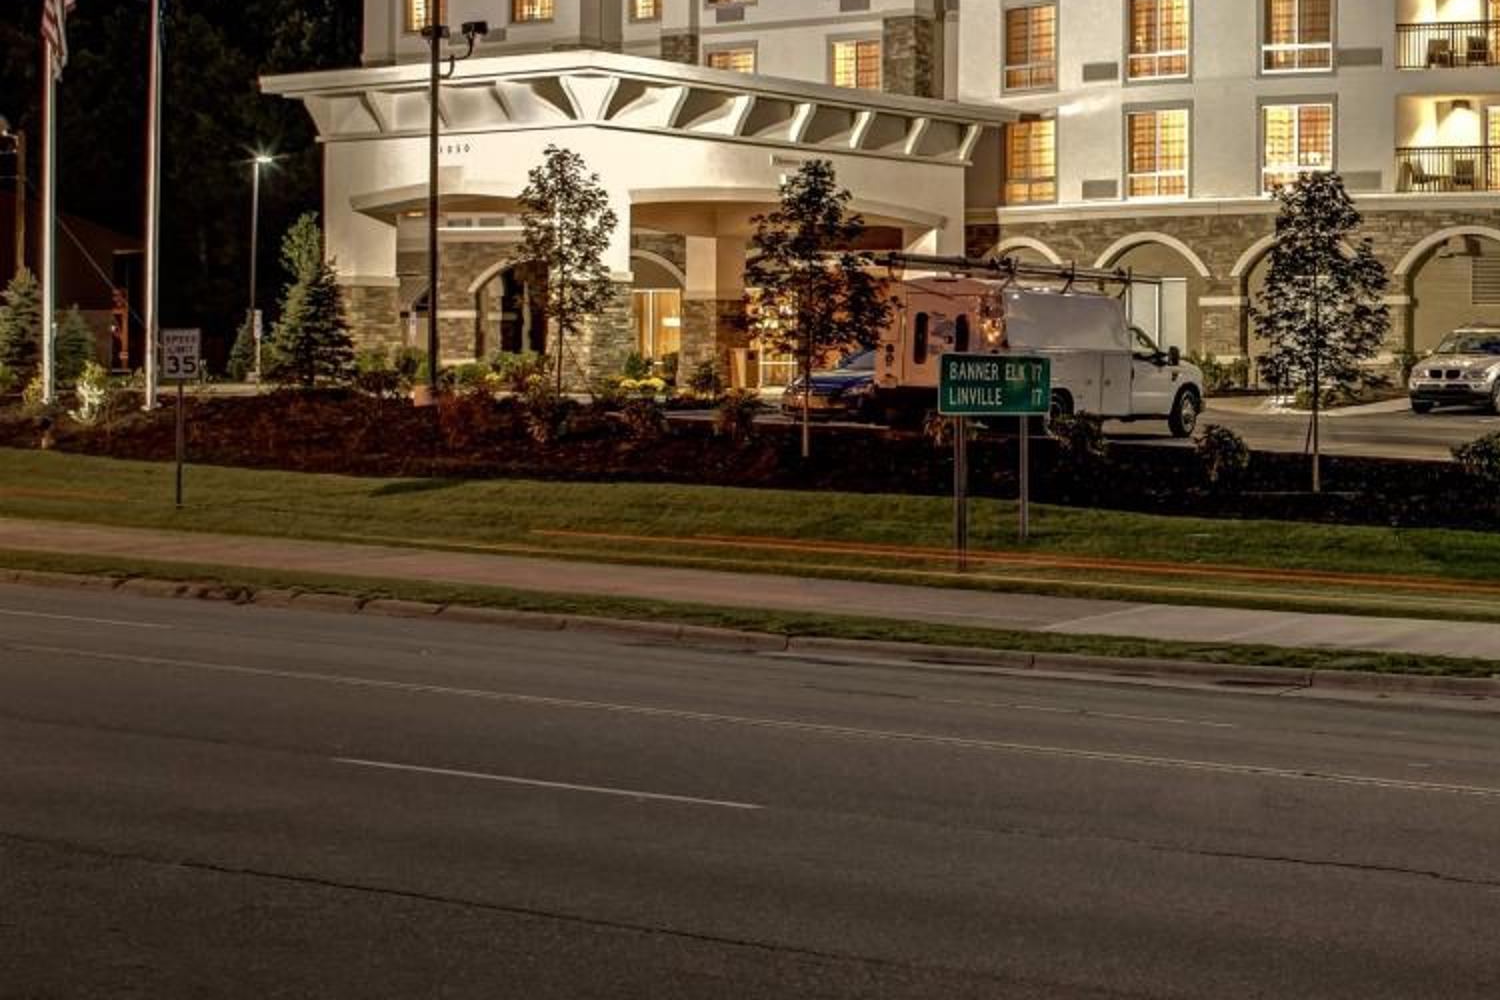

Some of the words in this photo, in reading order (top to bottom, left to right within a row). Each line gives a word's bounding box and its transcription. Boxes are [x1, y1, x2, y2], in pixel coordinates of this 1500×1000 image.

[167, 356, 196, 374] 35
[949, 362, 999, 381] BANNER
[949, 387, 1003, 406] LINVILLE
